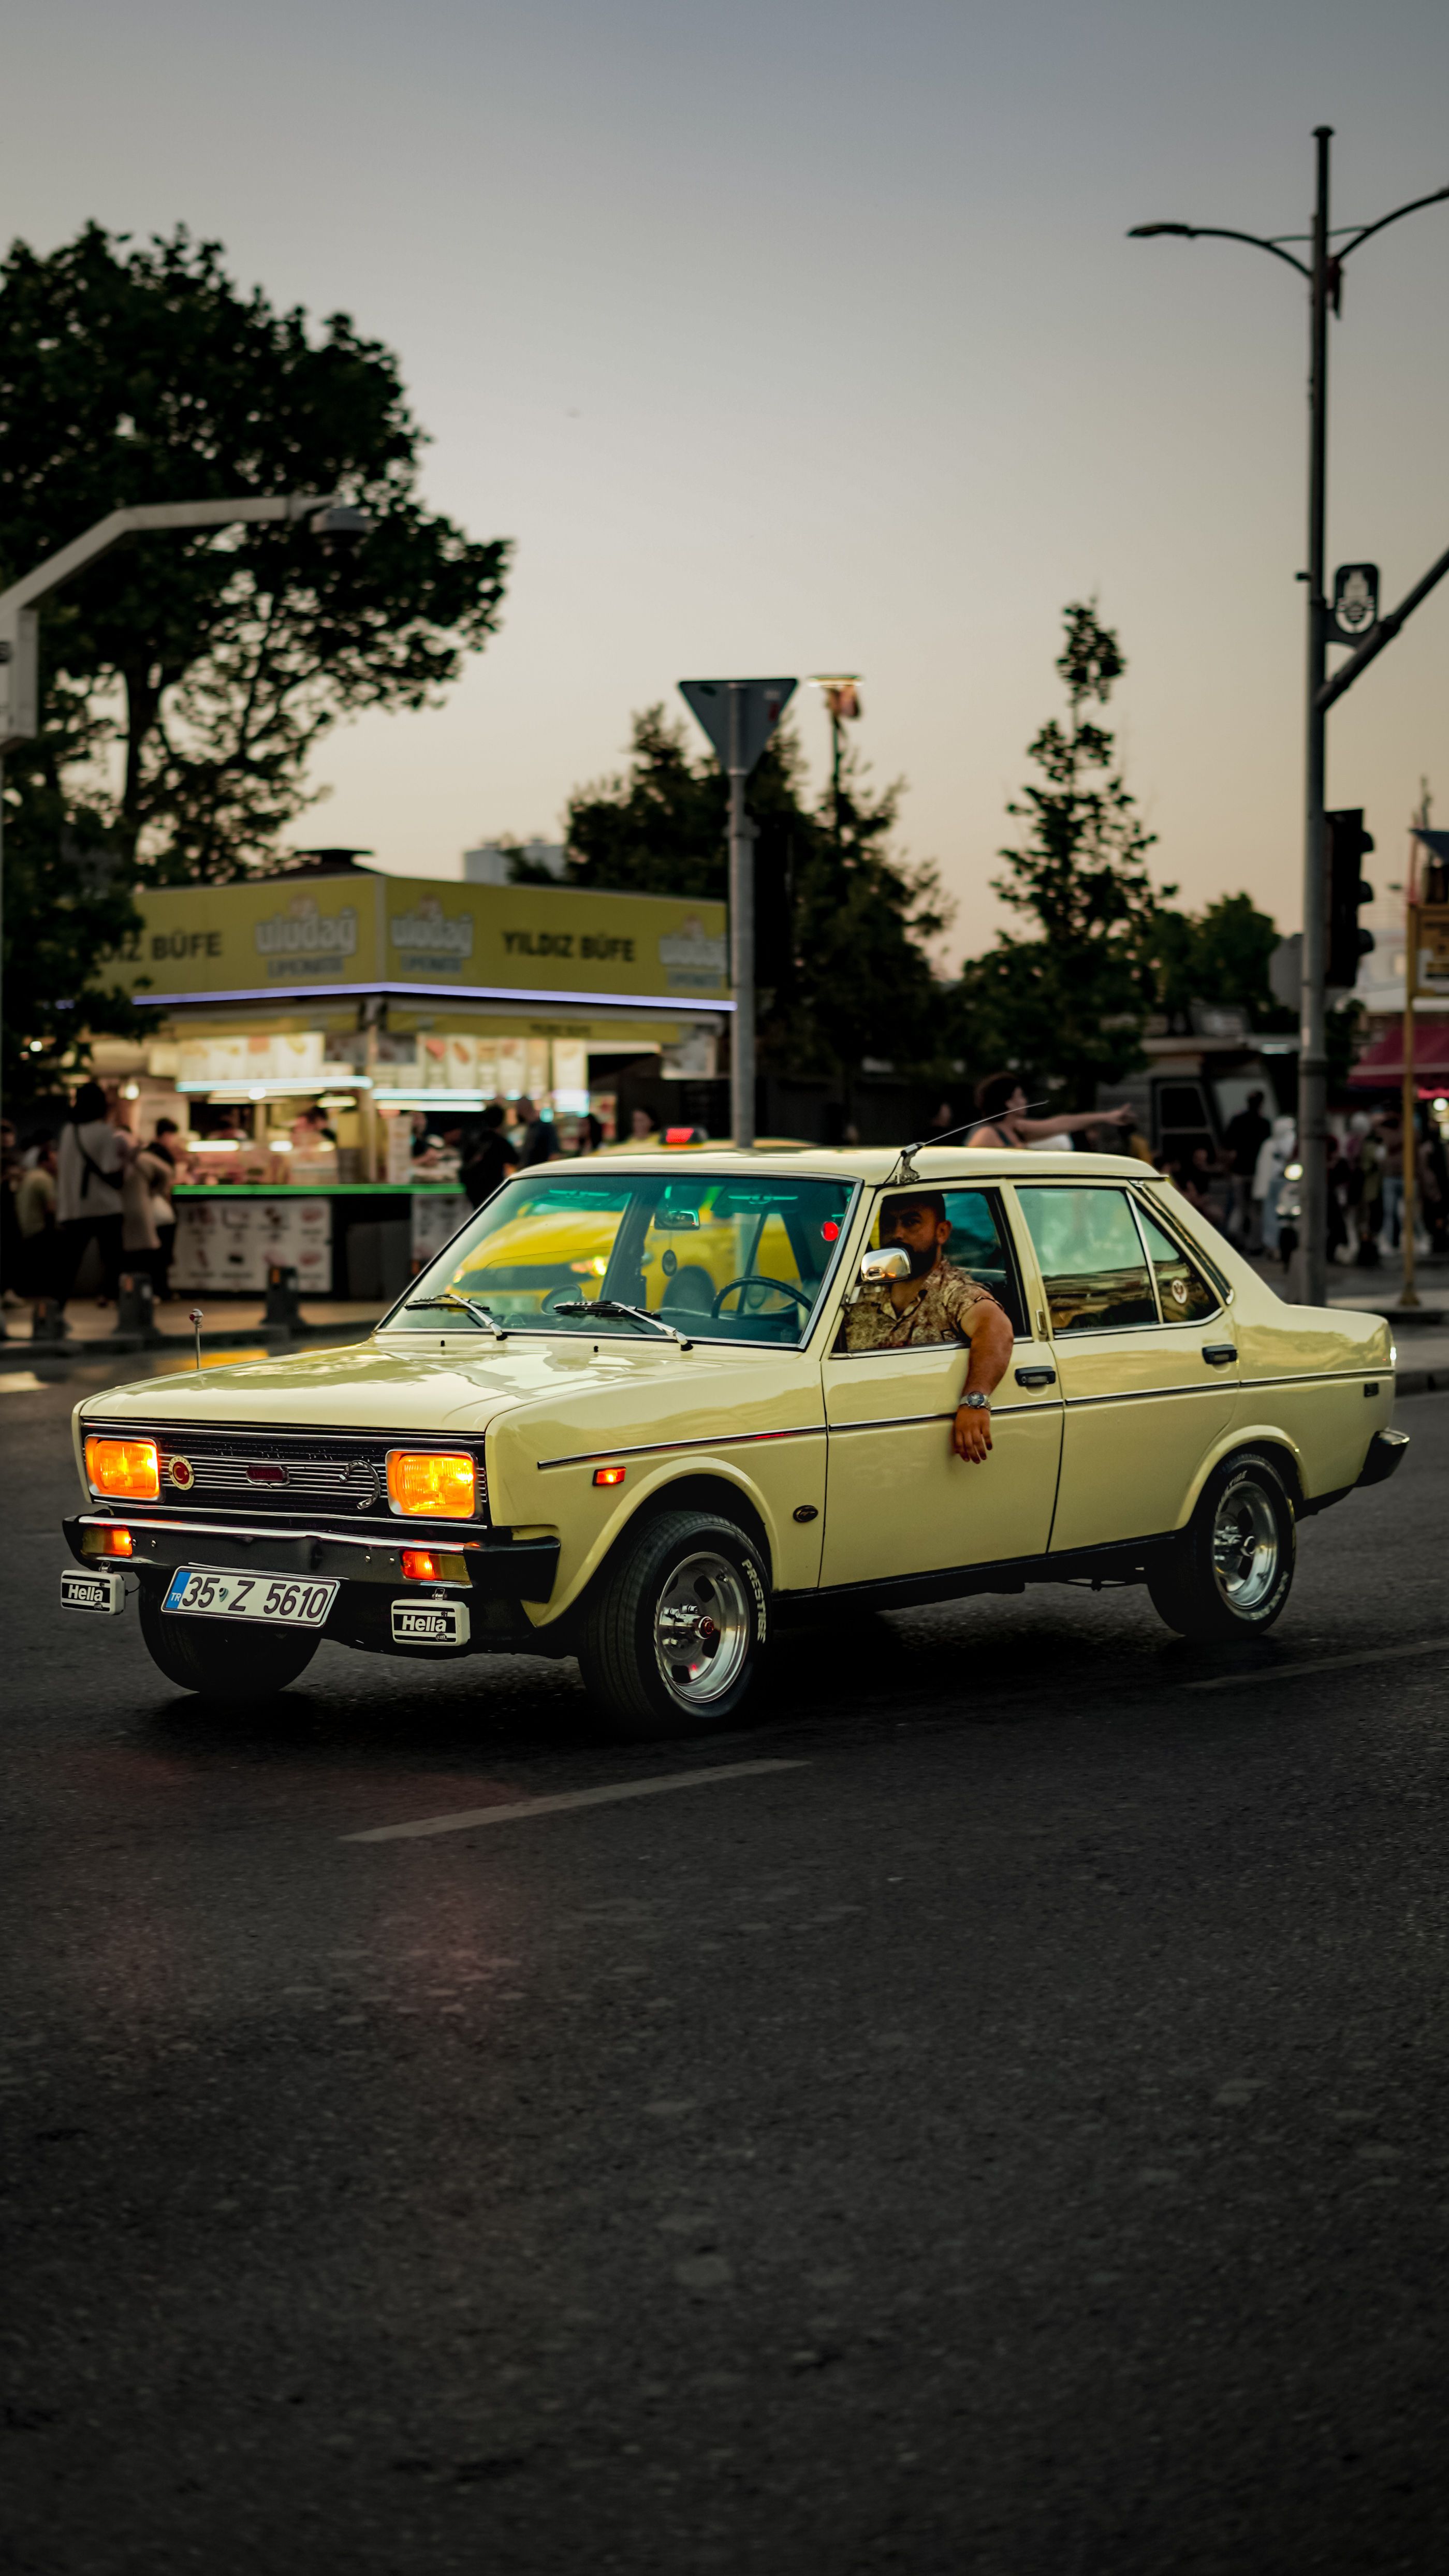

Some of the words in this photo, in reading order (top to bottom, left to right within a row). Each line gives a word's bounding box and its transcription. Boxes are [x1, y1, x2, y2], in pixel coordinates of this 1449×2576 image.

[152, 928, 222, 960] BÜFE
[502, 931, 573, 958] YILDIZ
[580, 931, 635, 962] BÜFE
[68, 1584, 104, 1602] Hella
[170, 1592, 181, 1602] TR
[182, 1576, 221, 1608] 35
[228, 1580, 256, 1612] Z
[263, 1583, 328, 1618] 5610
[402, 1615, 447, 1632] Hella
